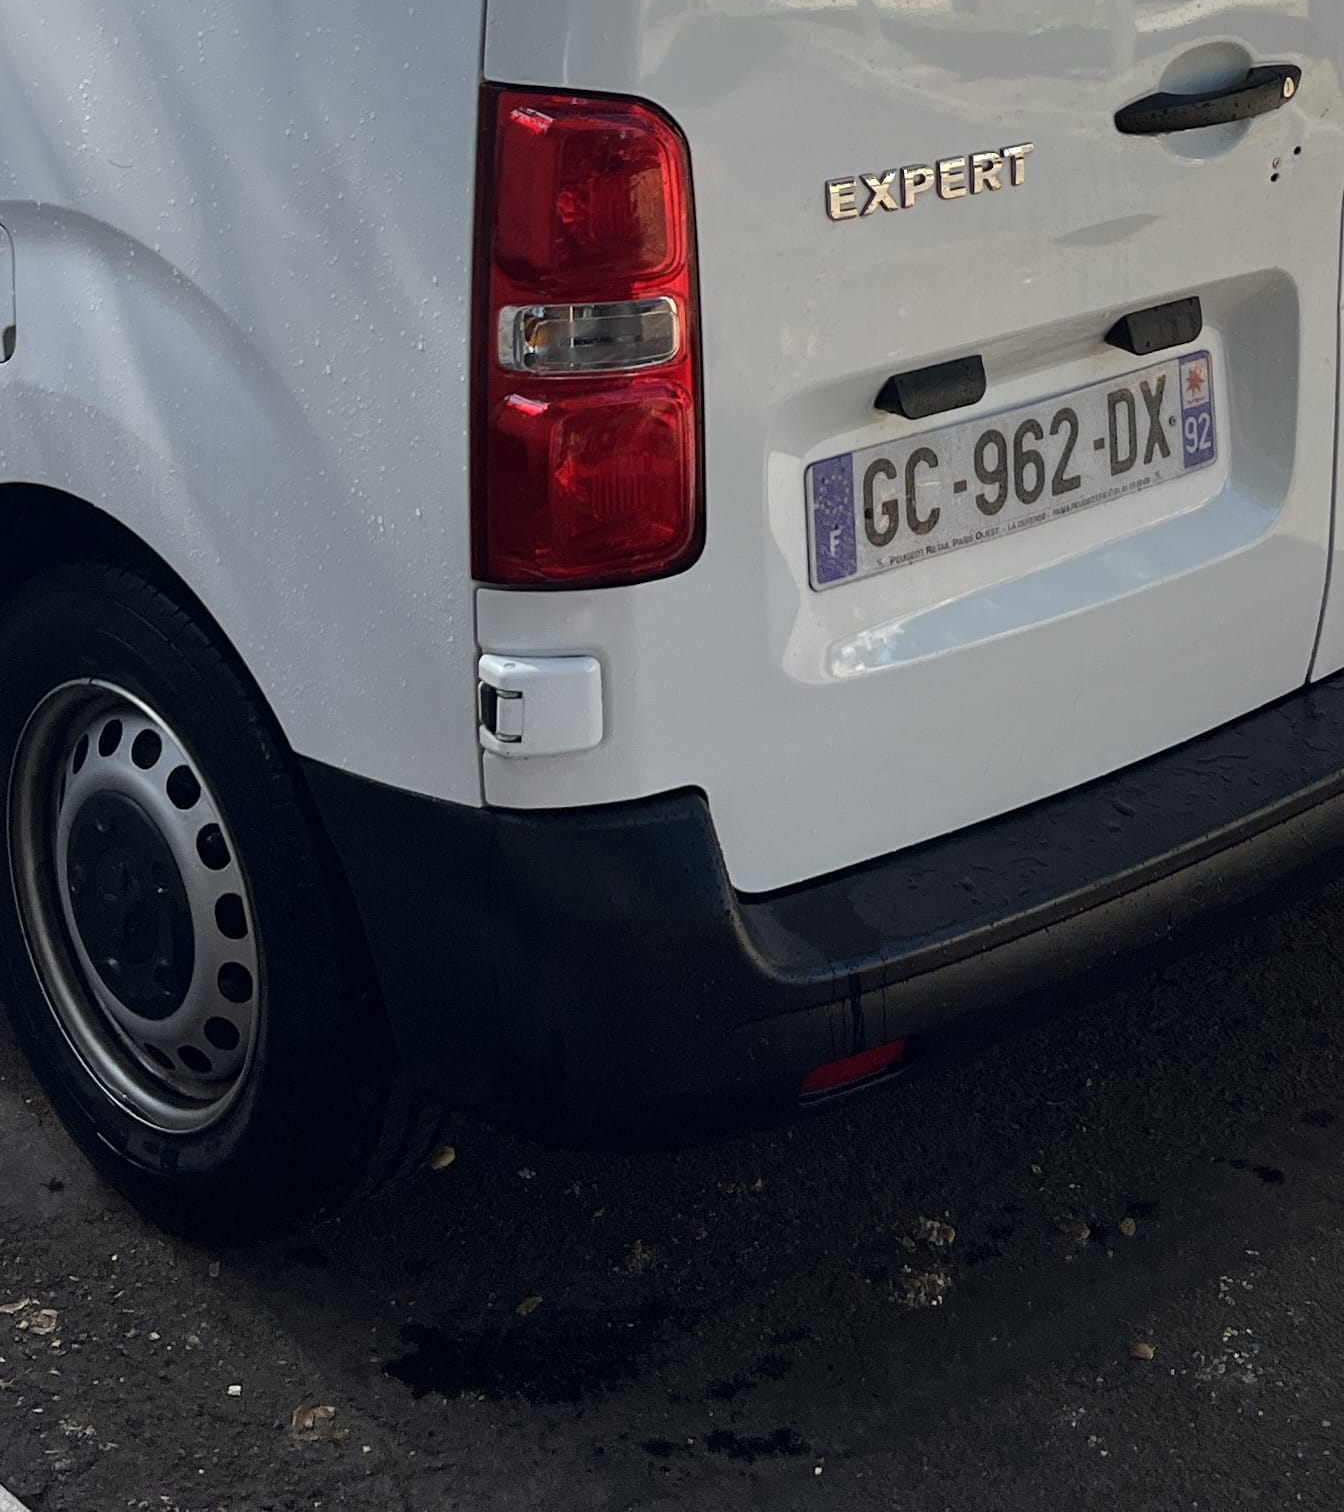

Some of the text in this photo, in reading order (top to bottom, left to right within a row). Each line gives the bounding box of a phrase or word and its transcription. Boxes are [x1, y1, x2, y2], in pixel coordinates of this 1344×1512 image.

[824, 142, 1035, 222] EXPERT
[862, 373, 1172, 548] GC-962-DX
[1184, 412, 1212, 455] 92
[829, 528, 842, 558] F
